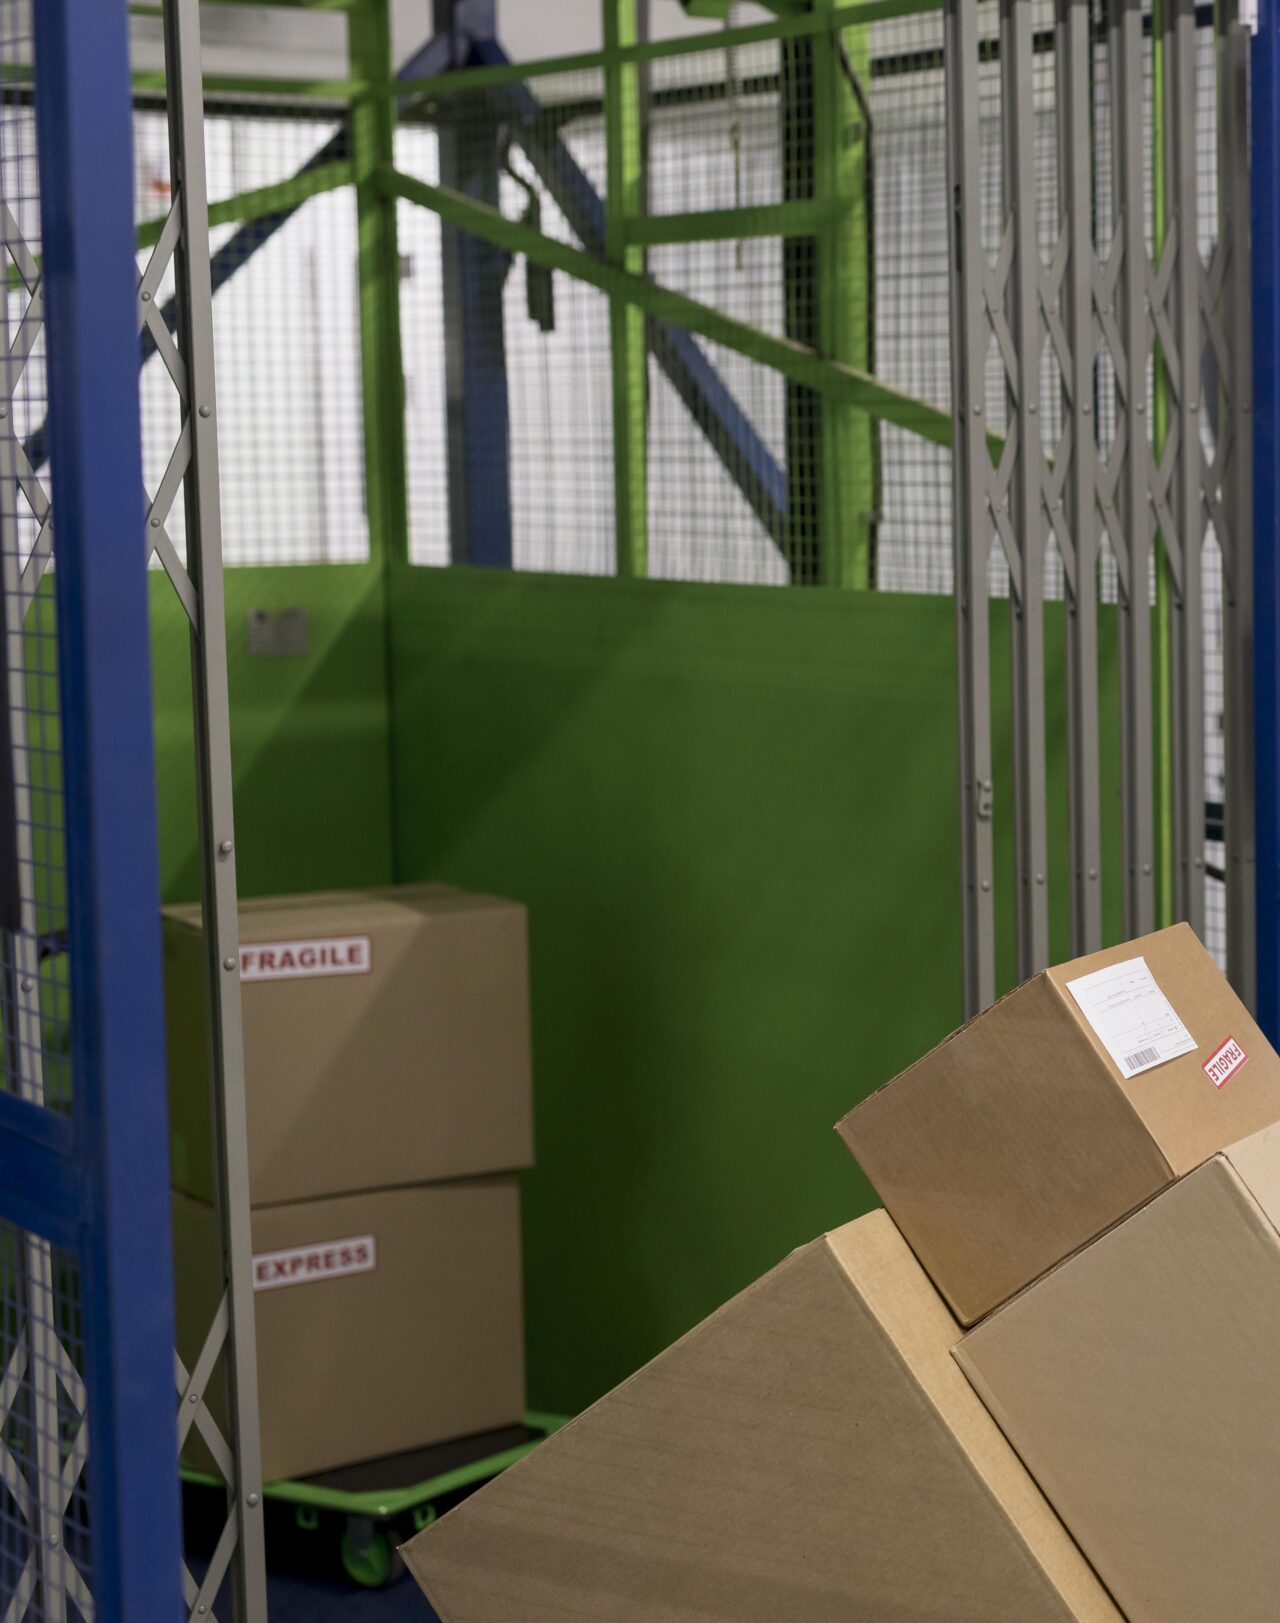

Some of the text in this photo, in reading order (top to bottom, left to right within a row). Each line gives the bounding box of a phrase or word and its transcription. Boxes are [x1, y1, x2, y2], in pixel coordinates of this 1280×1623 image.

[241, 943, 362, 972] FRAGILE
[1208, 1043, 1242, 1082] FRAGILE
[257, 1244, 369, 1282] EXPRESS
